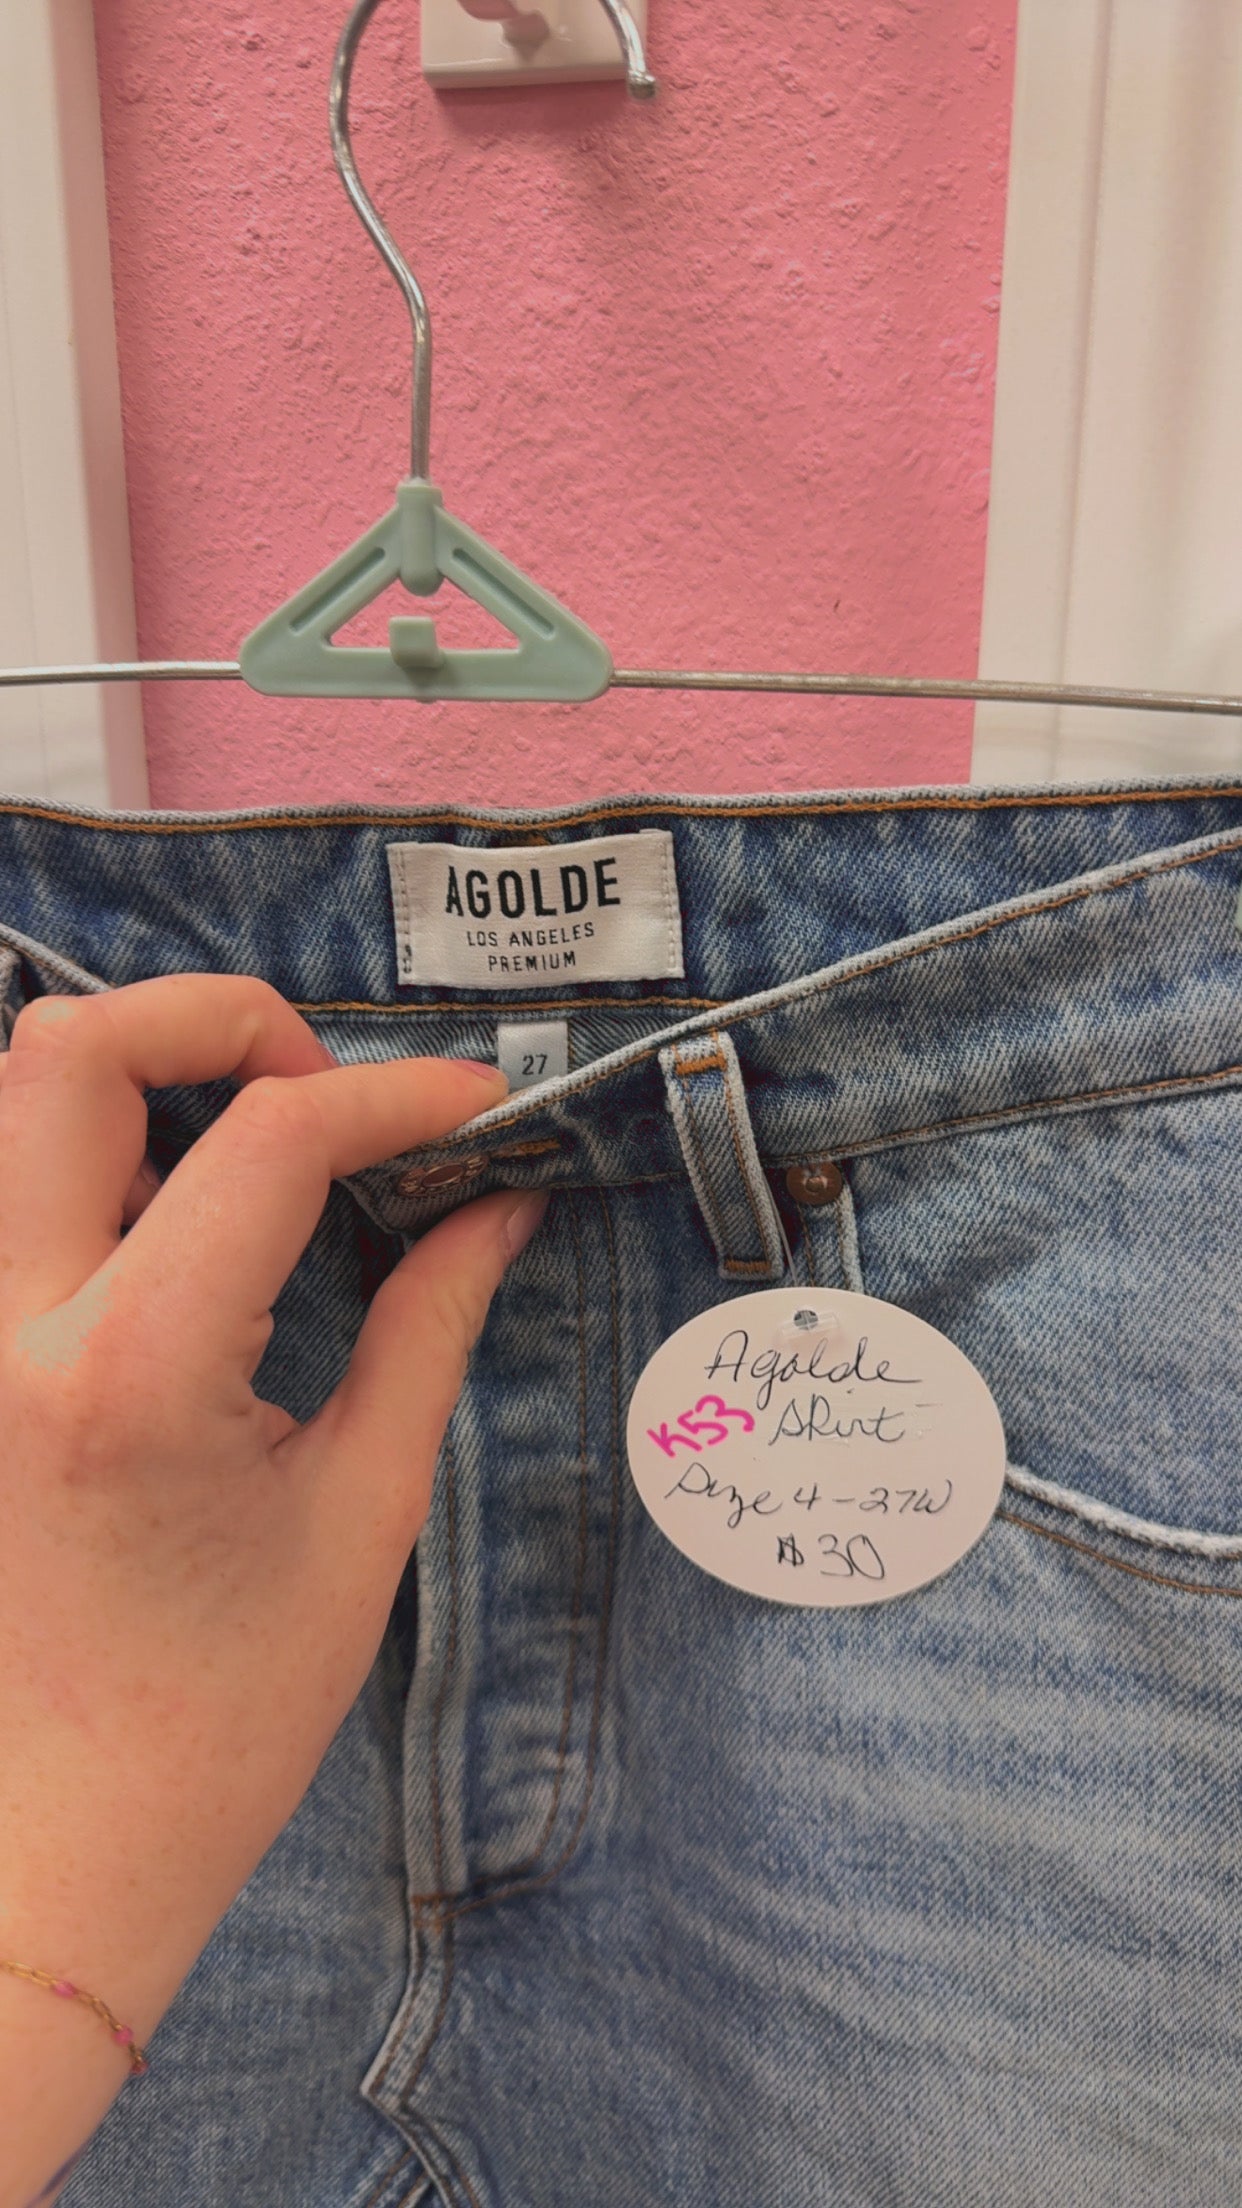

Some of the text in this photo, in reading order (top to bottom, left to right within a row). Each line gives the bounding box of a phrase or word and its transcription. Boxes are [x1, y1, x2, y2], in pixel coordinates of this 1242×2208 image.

[446, 857, 620, 919] AGOLDE
[467, 922, 594, 947] LOS ANGELES
[488, 951, 576, 972] PREMIUM
[522, 1054, 548, 1076] 27
[647, 1394, 755, 1459] K53
